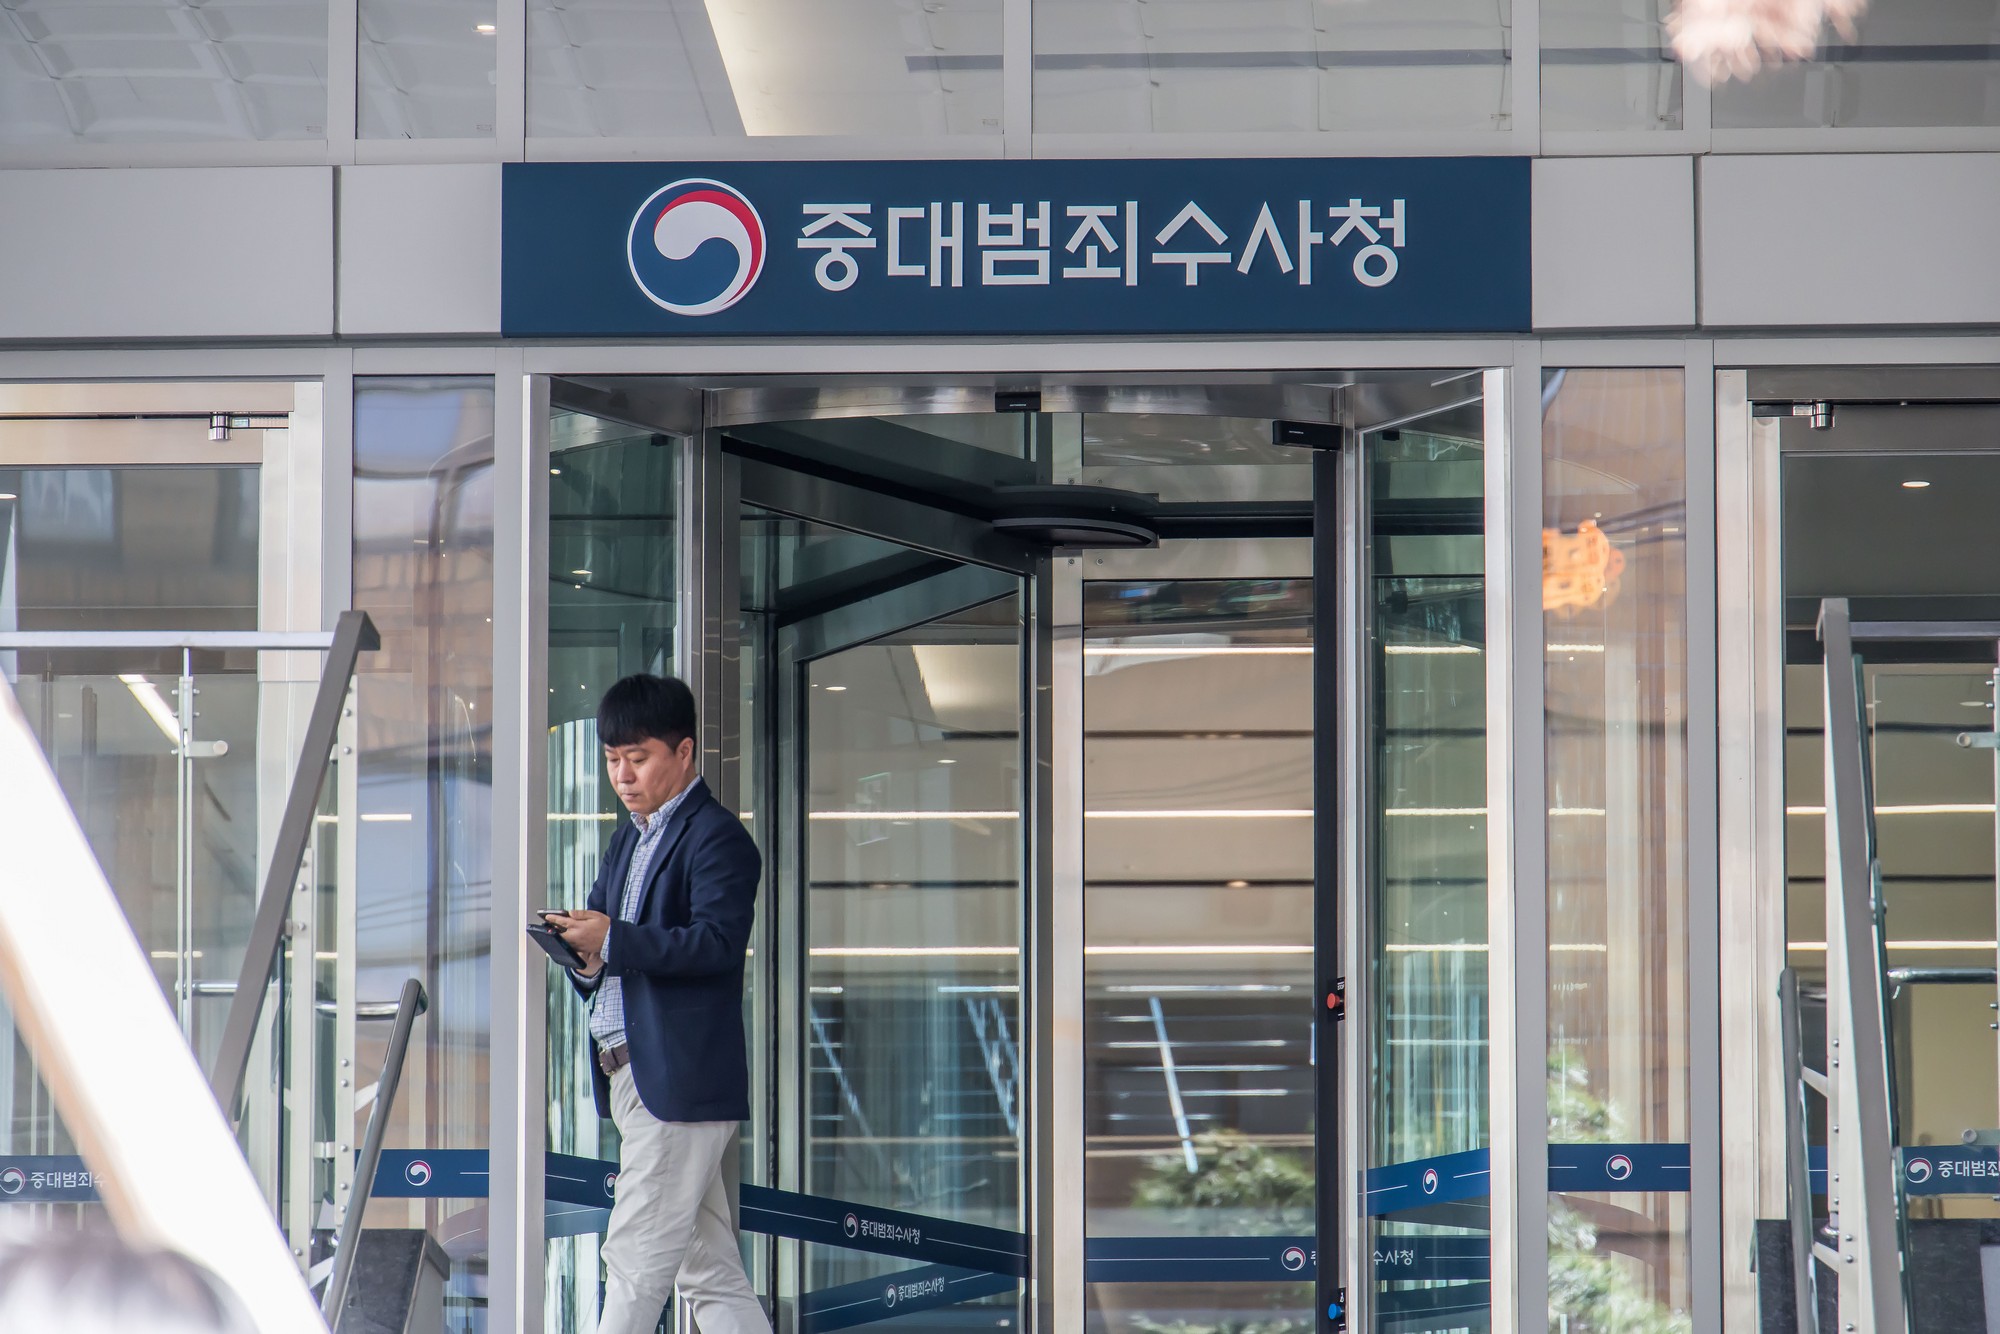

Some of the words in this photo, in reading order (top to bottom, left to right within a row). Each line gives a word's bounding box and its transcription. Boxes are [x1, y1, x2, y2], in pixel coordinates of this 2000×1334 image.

[797, 198, 1406, 292] 중대범죄수사청
[860, 1219, 921, 1245] 중대범죄수사청
[898, 1276, 945, 1302] 중대범죄수사청
